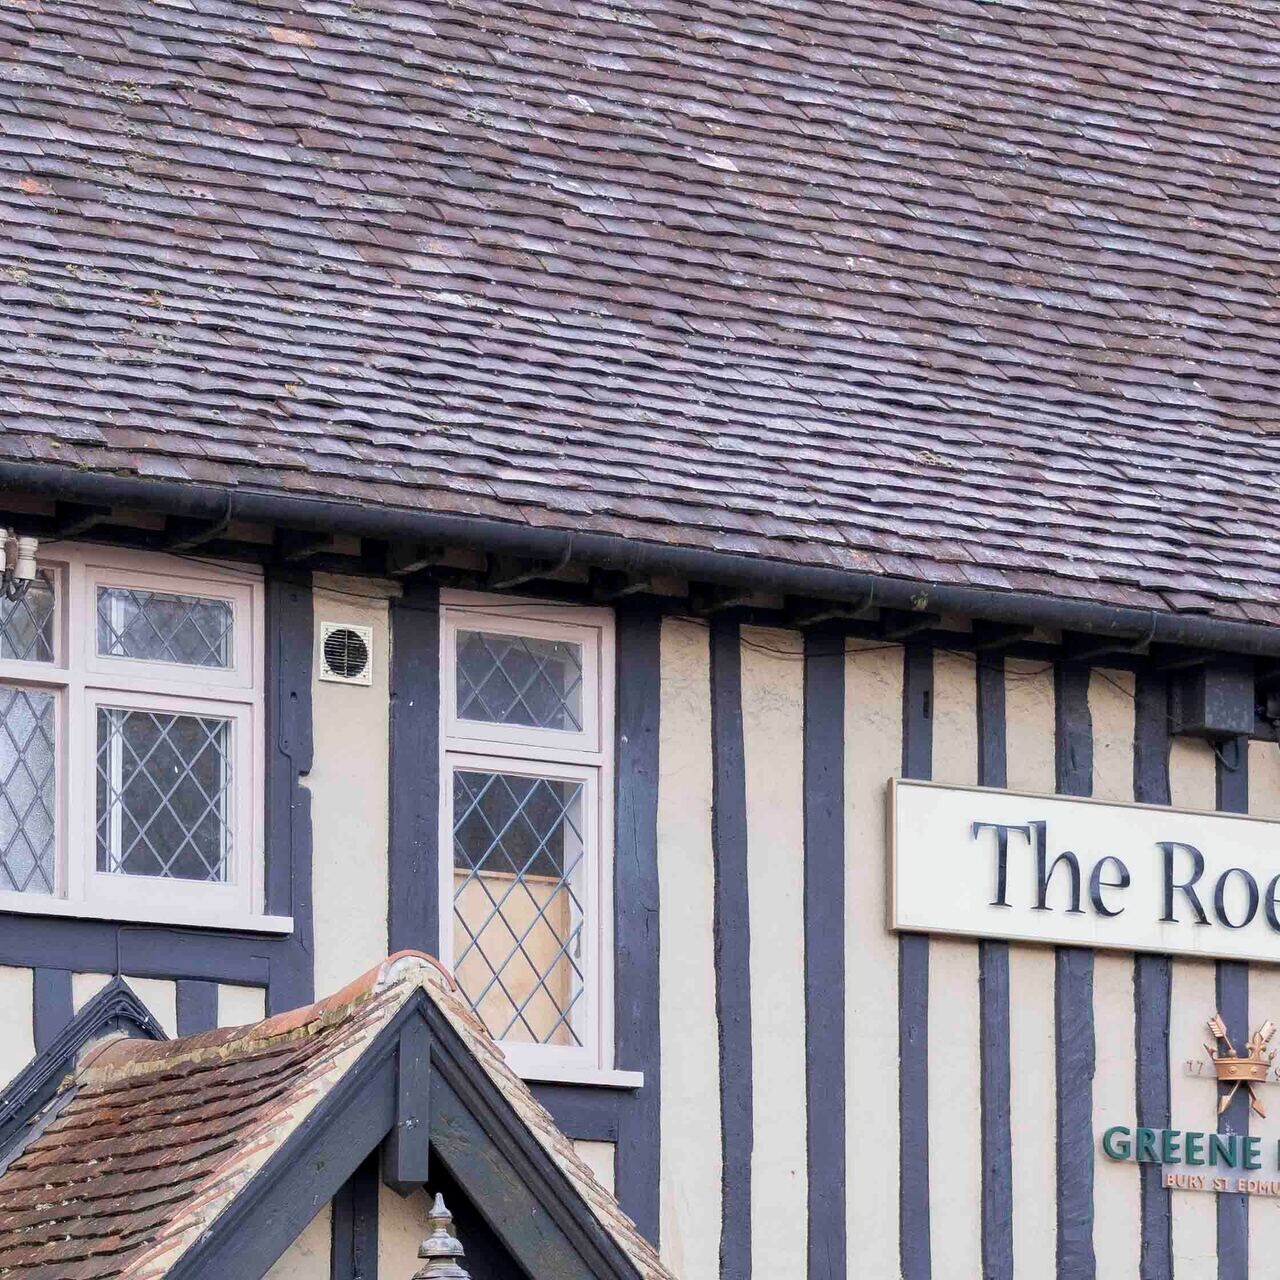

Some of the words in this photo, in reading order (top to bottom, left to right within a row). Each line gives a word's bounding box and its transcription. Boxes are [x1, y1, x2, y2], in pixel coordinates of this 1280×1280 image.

[972, 820, 1131, 918] The
[1102, 1126, 1262, 1170] GREENE
[1166, 1173, 1206, 1189] BURY
[1213, 1177, 1230, 1190] ST
